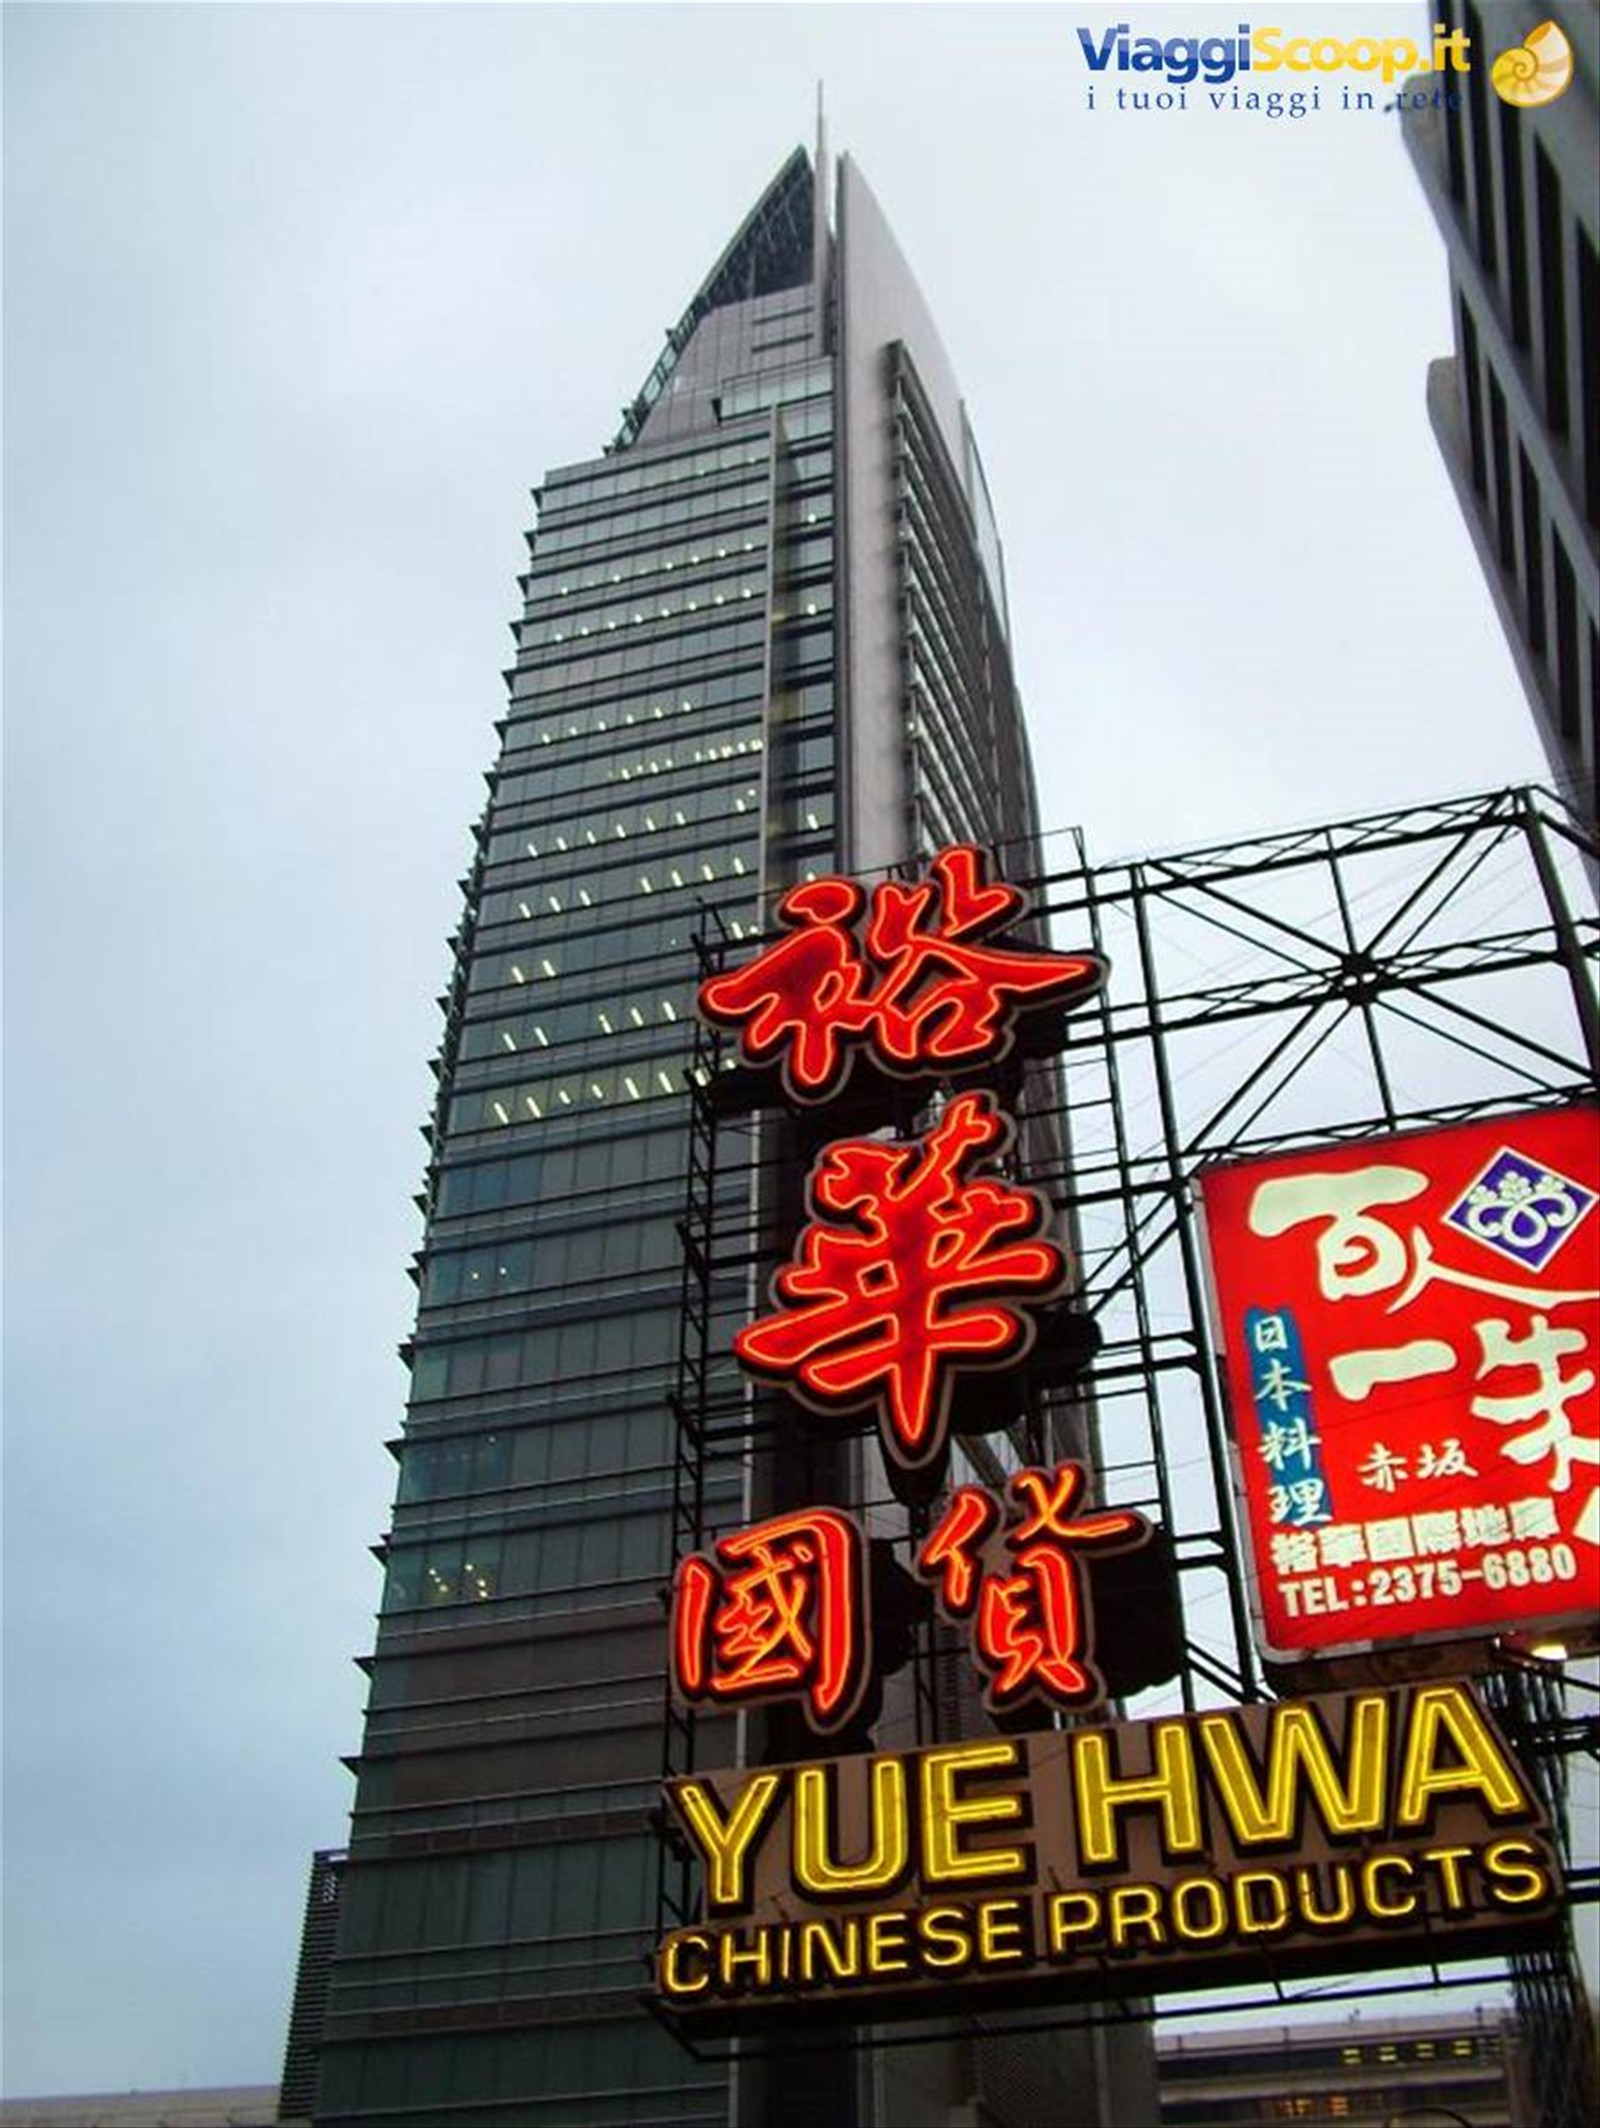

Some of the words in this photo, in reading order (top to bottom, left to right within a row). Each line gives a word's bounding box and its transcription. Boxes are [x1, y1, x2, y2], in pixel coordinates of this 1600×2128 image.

[1255, 1315, 1333, 1527] 日本料理
[1357, 1438, 1479, 1493] 赤坂
[677, 1740, 1025, 1907] YUE
[1072, 1683, 1526, 1865] HWA
[663, 1900, 1023, 1995] CHINESE
[1049, 1841, 1549, 1954] PRODUCTS
